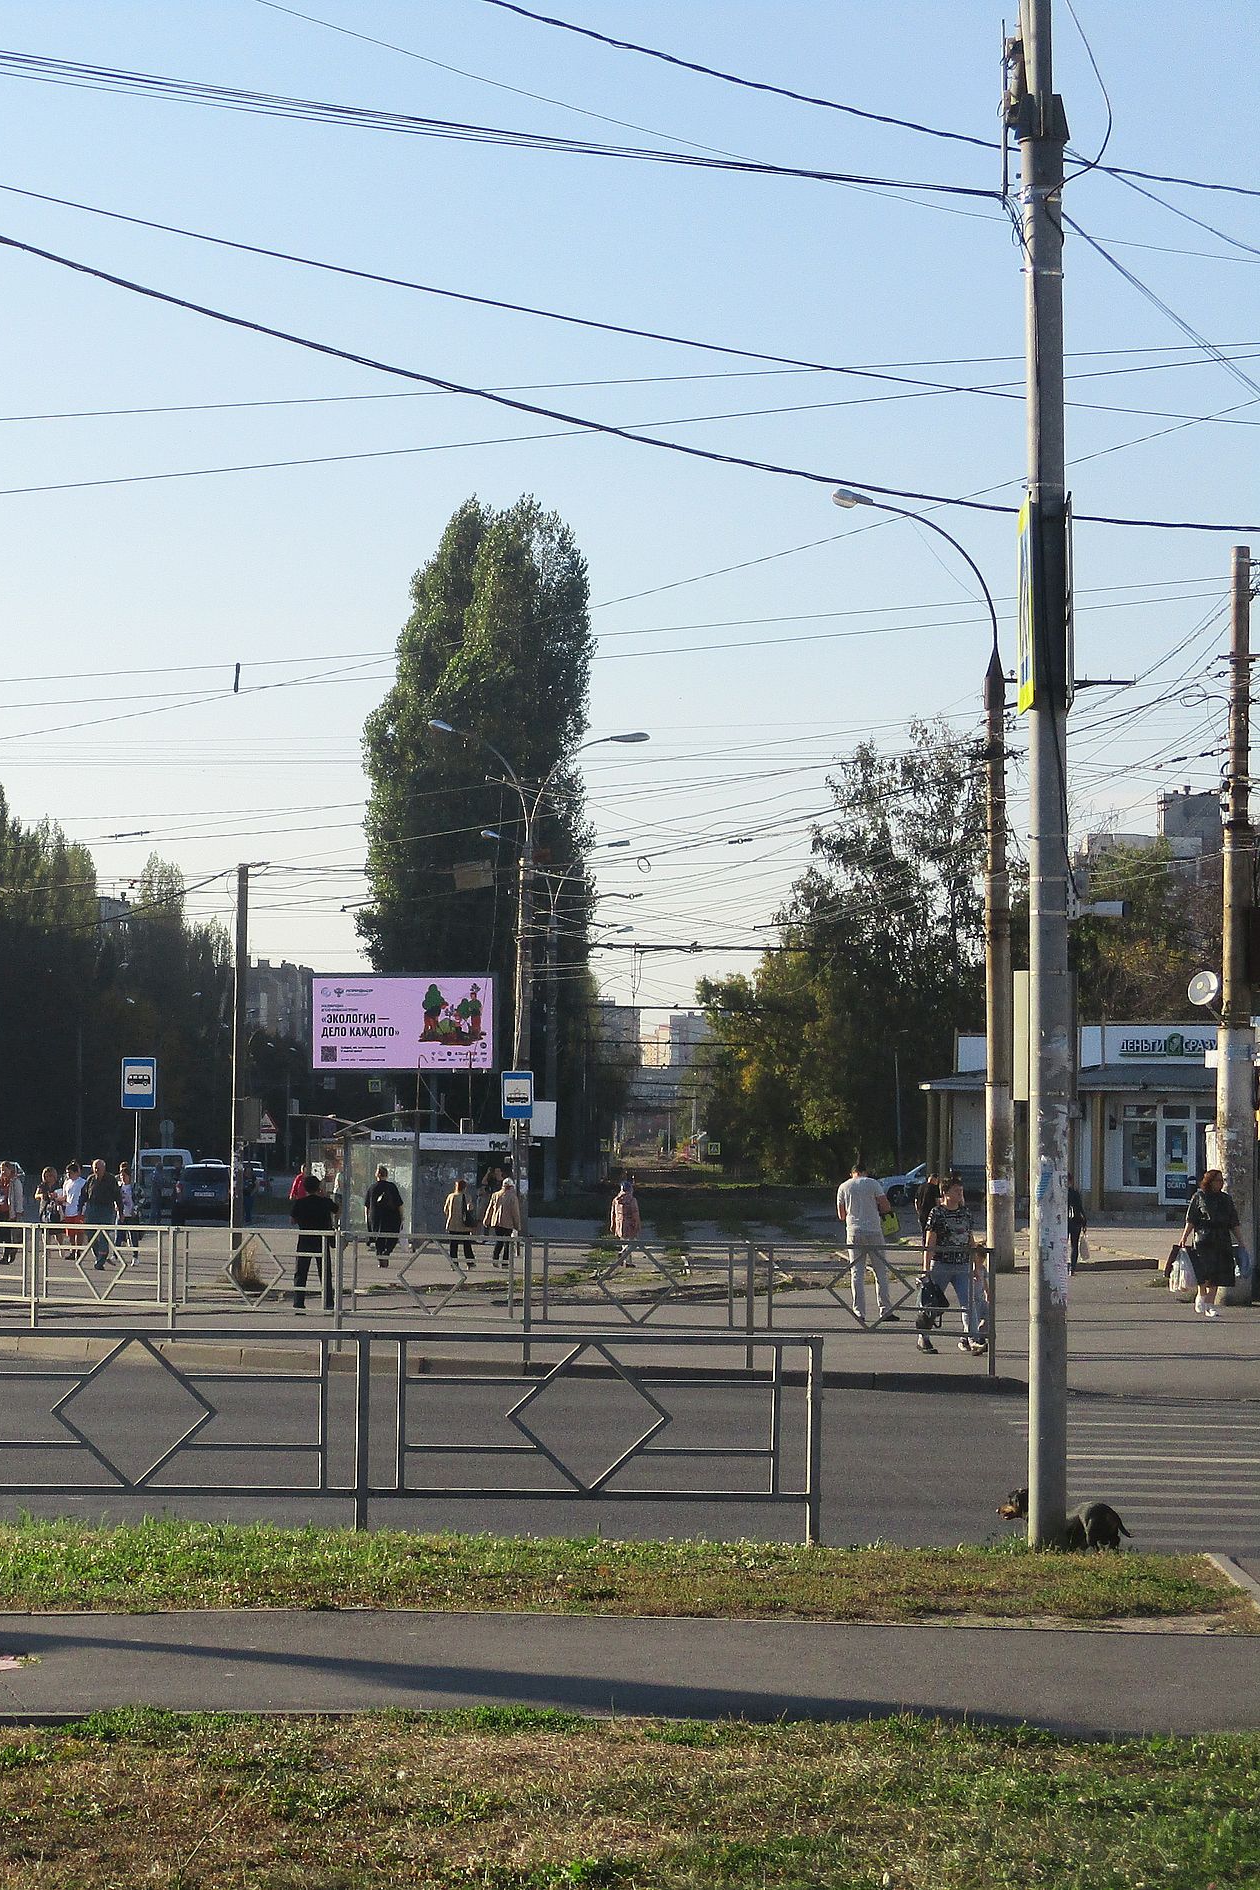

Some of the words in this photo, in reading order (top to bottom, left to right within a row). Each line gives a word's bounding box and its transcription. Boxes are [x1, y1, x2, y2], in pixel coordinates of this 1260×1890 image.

[322, 1013, 376, 1024] «ЭКОЛОГИЯ
[321, 1026, 347, 1038] ДЕЛО
[349, 1026, 400, 1038] КАЖДОГО»
[1121, 1038, 1166, 1053] ДЕНЬГИ
